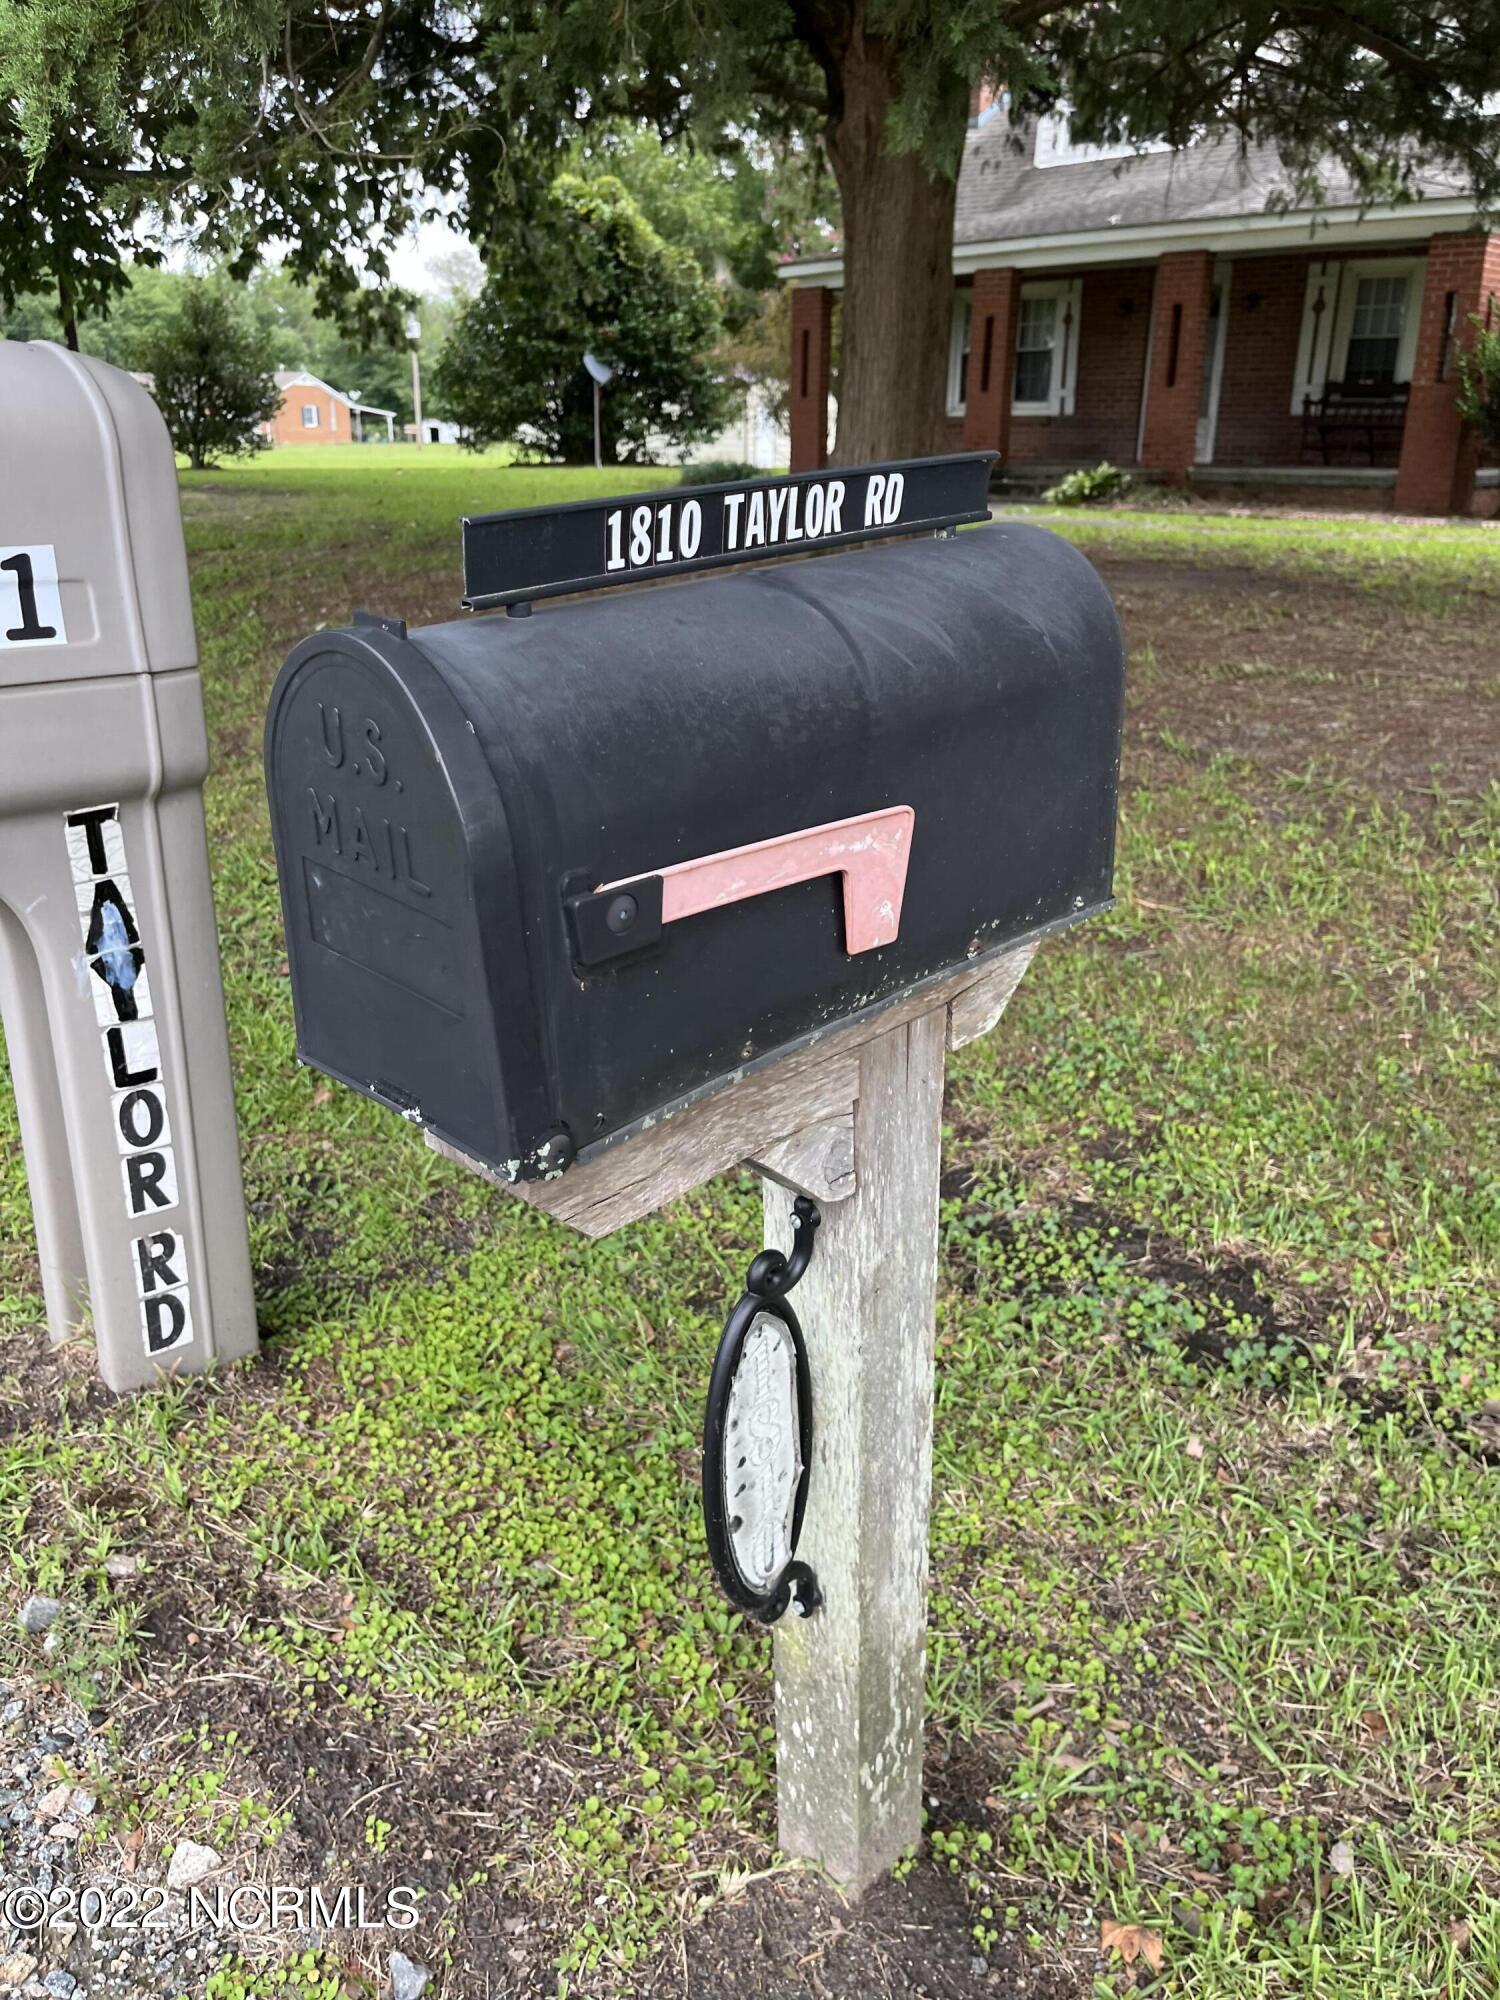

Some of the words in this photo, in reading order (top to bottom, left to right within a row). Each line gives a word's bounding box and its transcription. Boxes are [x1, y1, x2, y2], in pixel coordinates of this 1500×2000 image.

[606, 499, 702, 571] 1810
[723, 480, 846, 550] TAYLOR
[864, 472, 905, 527] RD
[1, 553, 57, 641] 1
[317, 702, 404, 788] U.S.
[307, 787, 432, 893] MAIL
[138, 1231, 186, 1353] RD
